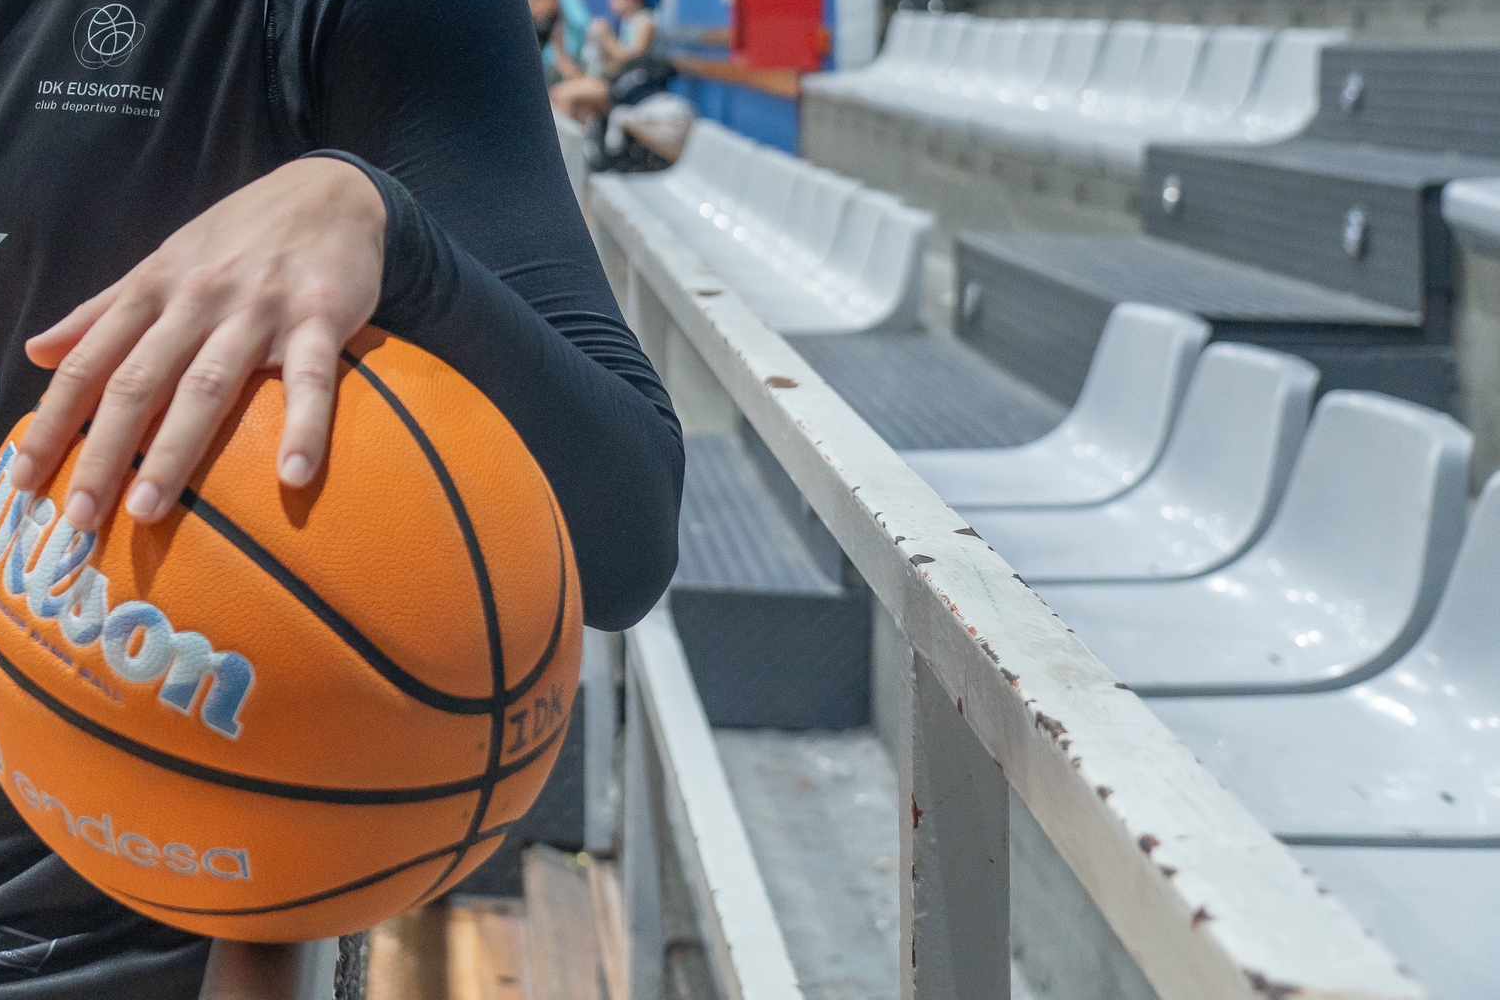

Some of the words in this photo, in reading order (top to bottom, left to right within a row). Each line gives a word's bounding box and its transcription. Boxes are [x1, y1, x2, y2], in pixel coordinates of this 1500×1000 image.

[37, 80, 64, 95] IDK
[66, 81, 165, 102] EUSKOTREN
[34, 99, 58, 111] club
[61, 100, 117, 114] deportivo
[121, 103, 161, 118] ibaeta
[11, 770, 251, 880] endesa
